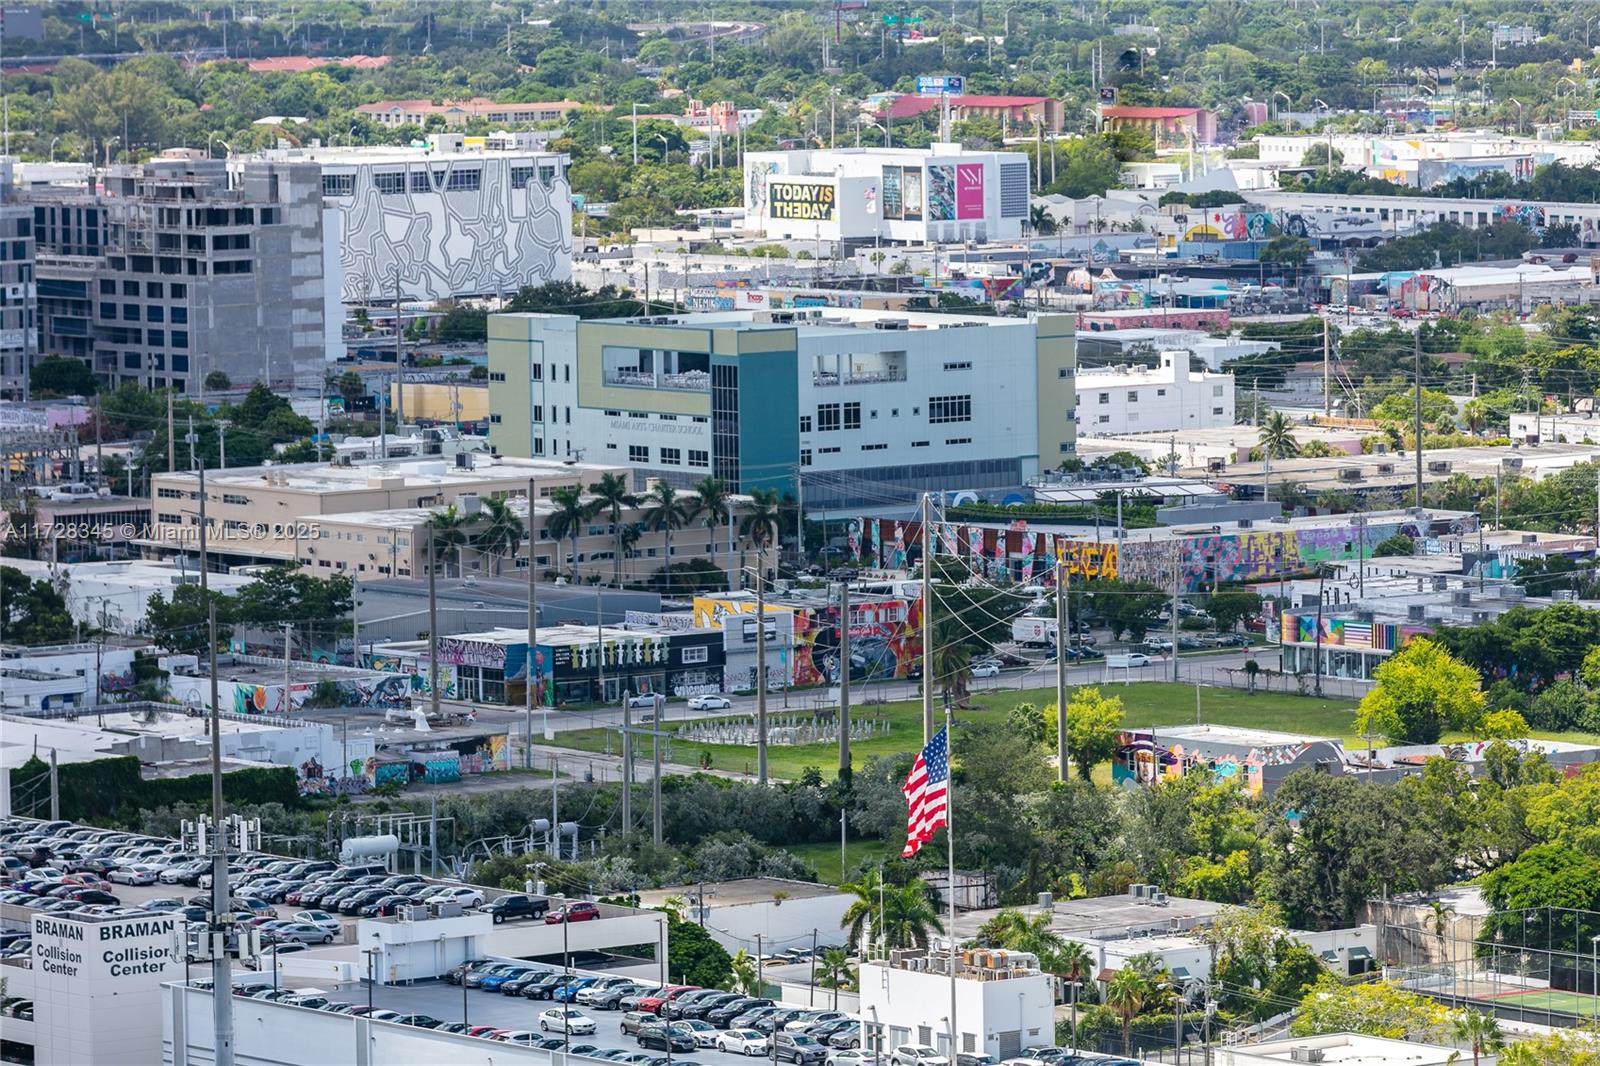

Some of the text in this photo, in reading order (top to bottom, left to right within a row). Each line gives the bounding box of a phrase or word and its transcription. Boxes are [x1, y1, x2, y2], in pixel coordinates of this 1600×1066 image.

[773, 184, 833, 203] TODAY IS
[610, 420, 704, 436] MIAMI ARTS CHARTER SCHOOL
[35, 919, 84, 941] BRAMAN
[99, 919, 175, 941] BRAMAN
[36, 944, 82, 964] Collision
[42, 959, 78, 977] Center
[110, 961, 167, 977] Center
